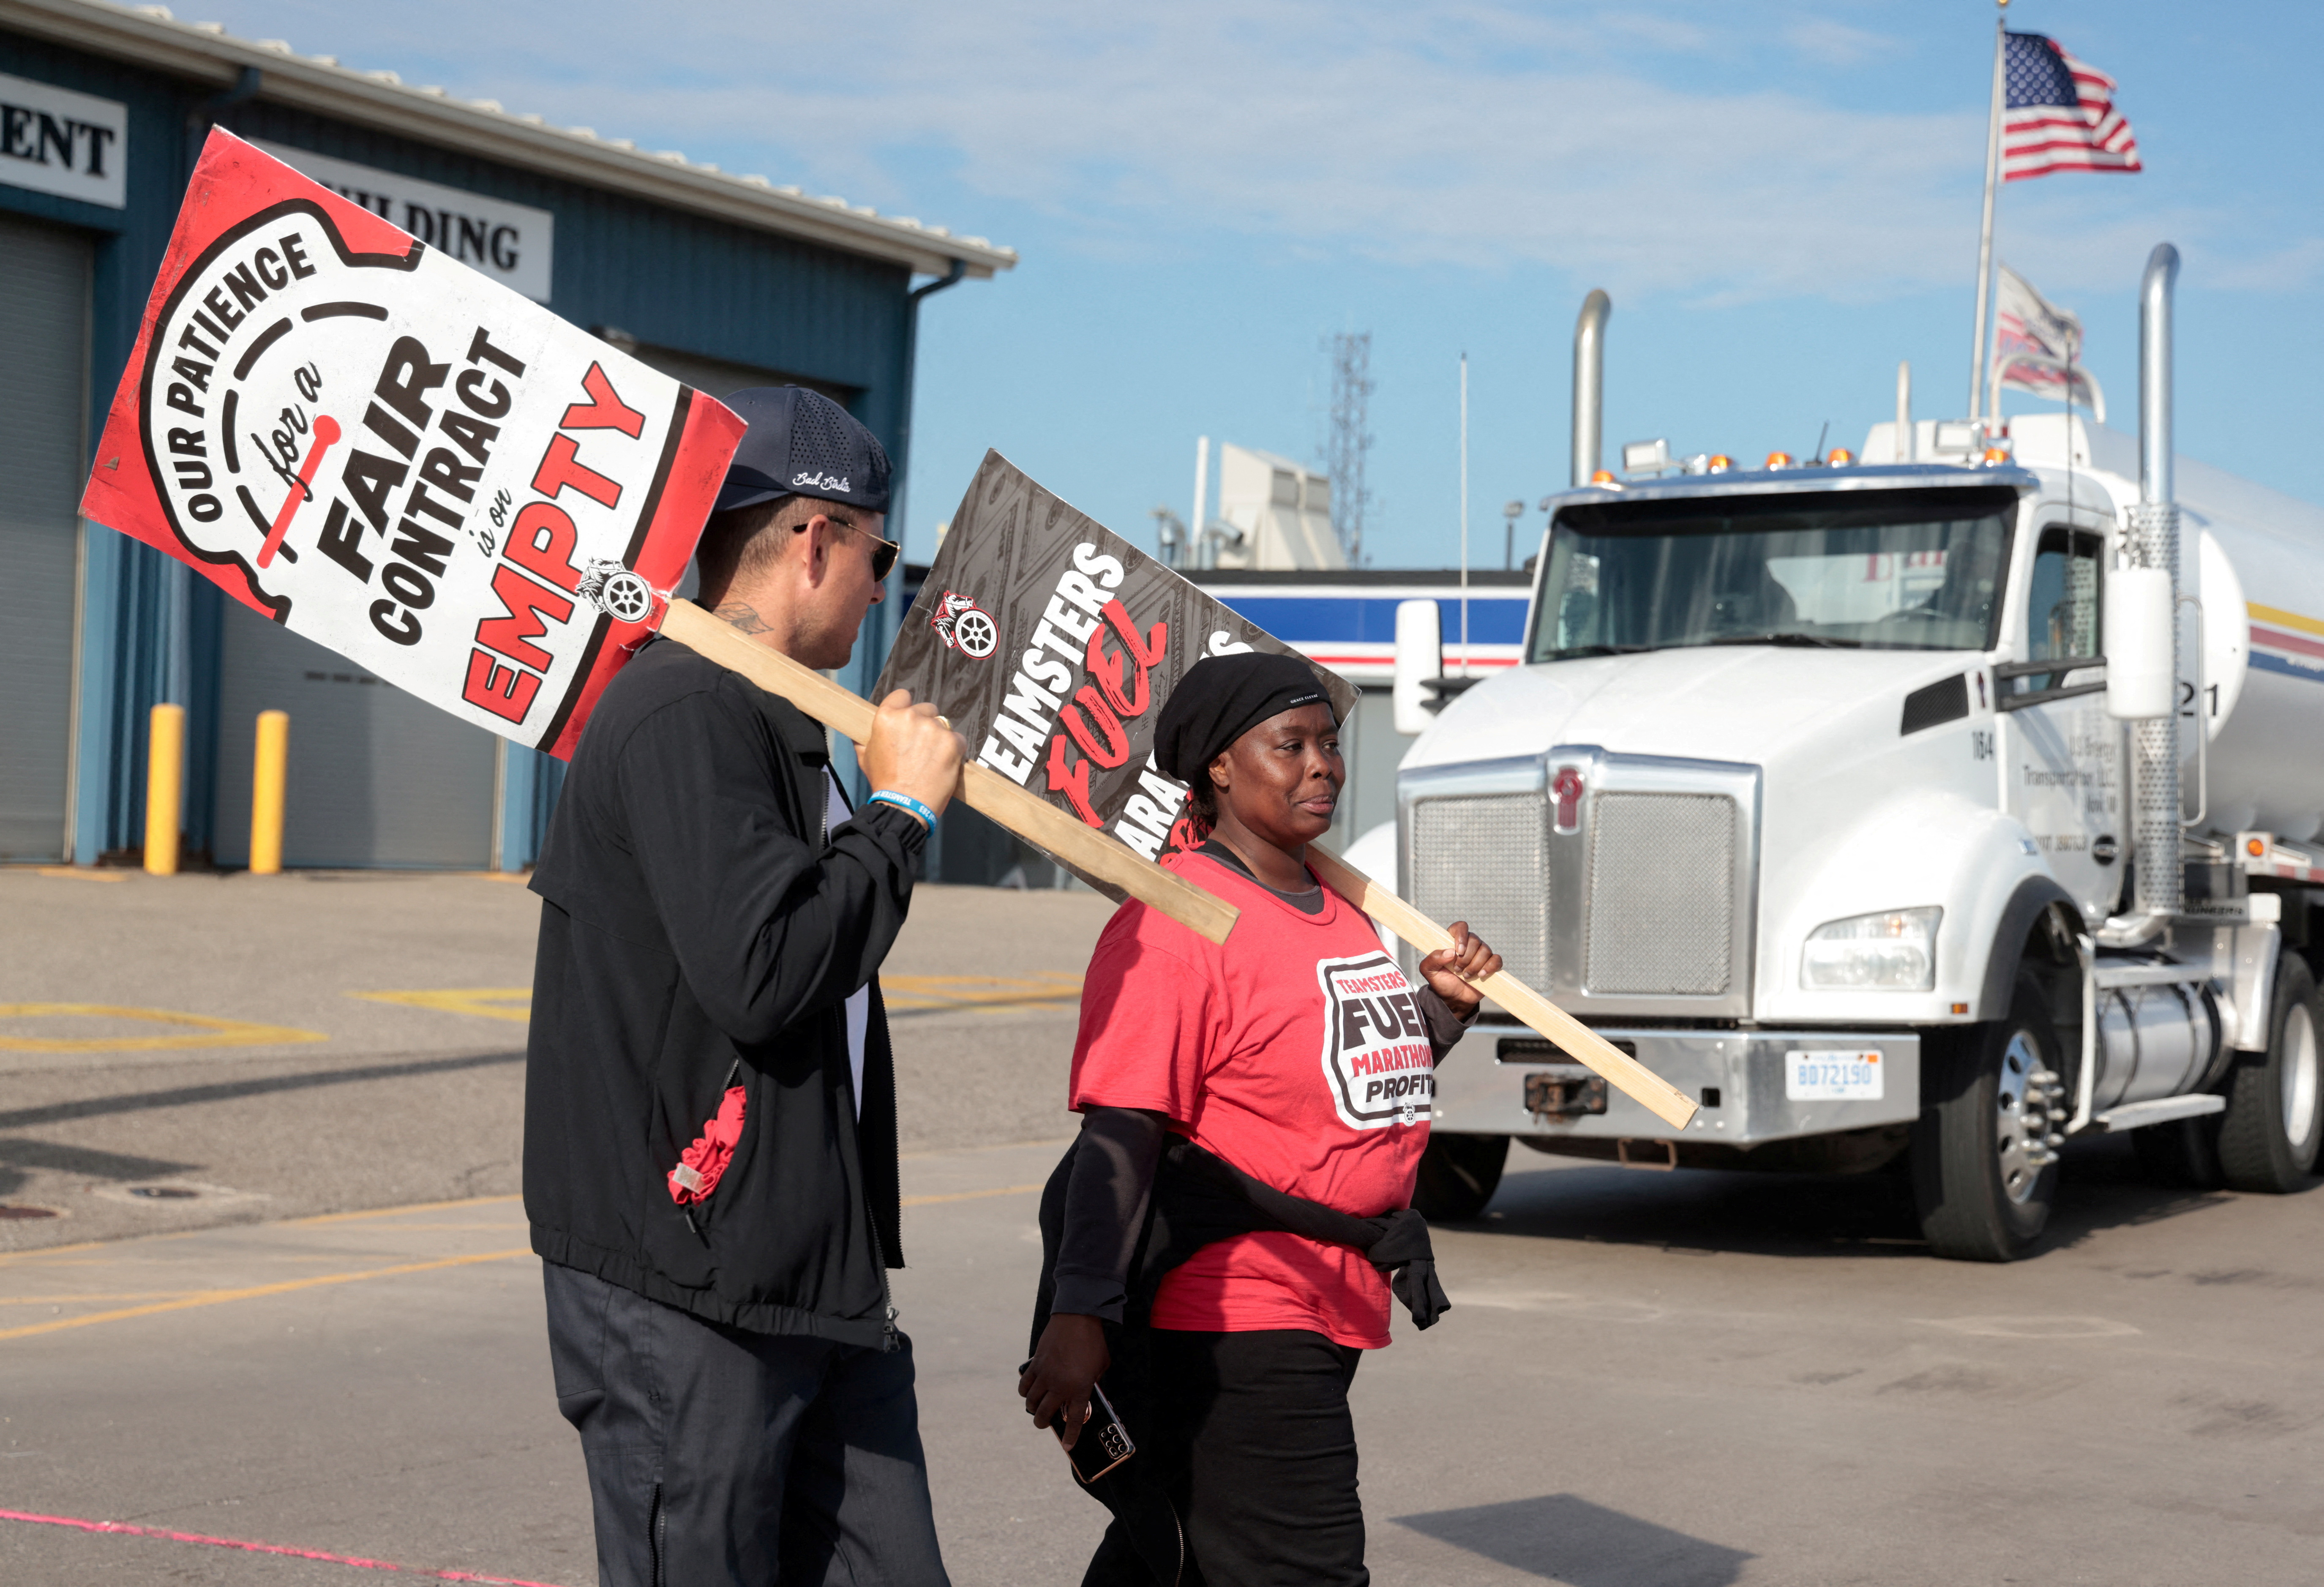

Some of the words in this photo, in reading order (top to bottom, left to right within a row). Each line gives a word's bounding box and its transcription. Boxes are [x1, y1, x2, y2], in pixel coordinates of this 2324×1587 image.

[167, 232, 316, 418] PATIENCE
[168, 427, 223, 522] OUR
[251, 403, 313, 502] for
[294, 361, 322, 403] a
[317, 336, 450, 584] FAIR
[370, 327, 526, 646] CONTRACT
[793, 472, 823, 485] Bad
[820, 477, 851, 492] Birdie
[461, 360, 646, 726] EMPTY
[469, 528, 496, 558] is
[489, 488, 512, 527] on
[974, 613, 990, 624] Teamsters
[976, 543, 1124, 787] EAMSTERS
[1046, 599, 1167, 829] FUEL
[880, 791, 911, 805] TEAMSTER
[919, 805, 930, 817] 283
[1336, 971, 1406, 994] TEAMSTERS
